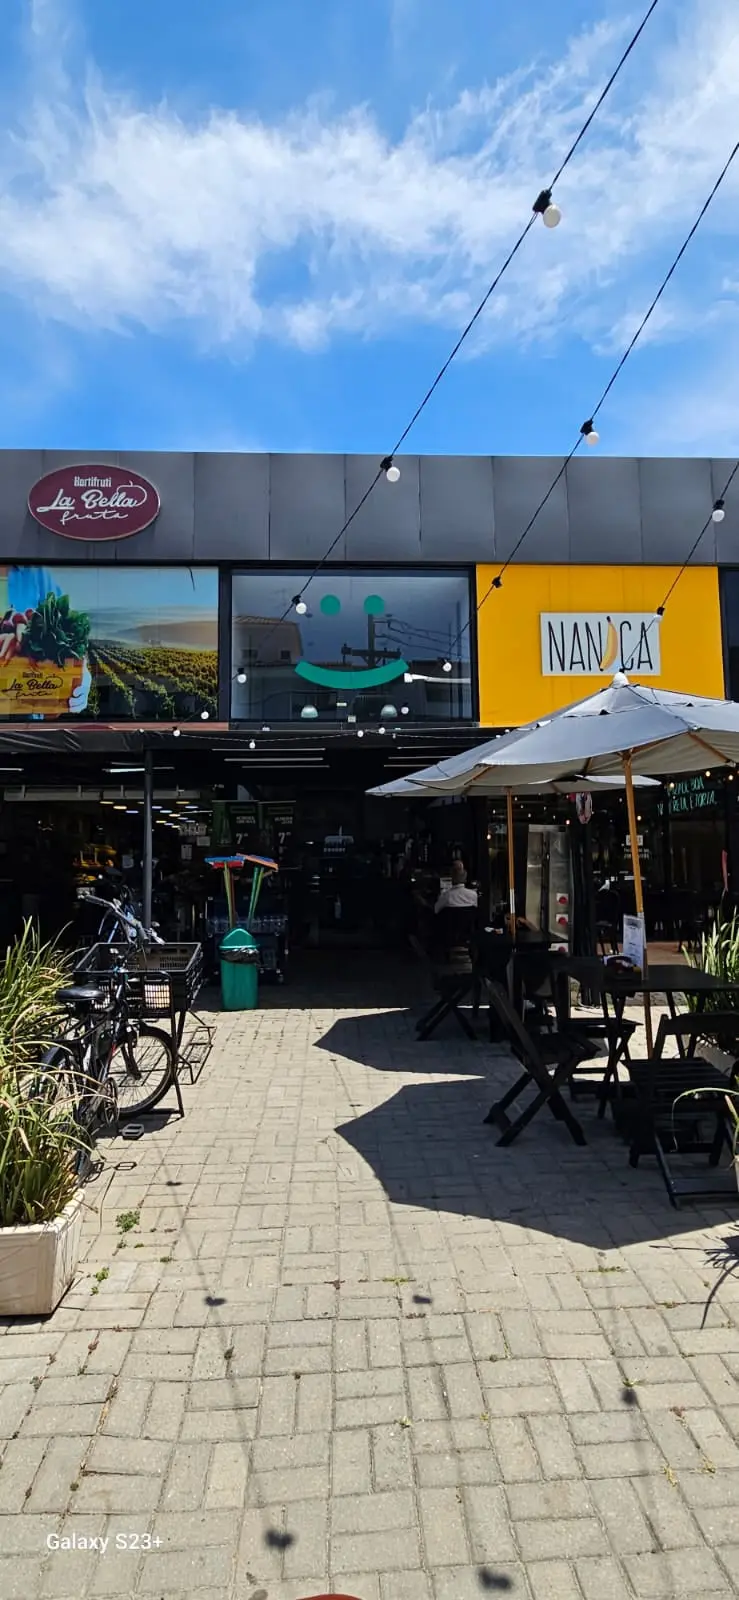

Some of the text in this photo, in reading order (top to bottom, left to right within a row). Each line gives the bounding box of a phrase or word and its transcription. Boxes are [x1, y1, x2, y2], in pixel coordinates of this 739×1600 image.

[73, 476, 112, 488] Hortifruti
[36, 487, 139, 512] La Bella
[60, 509, 129, 526] fruta
[26, 678, 58, 690] Bella
